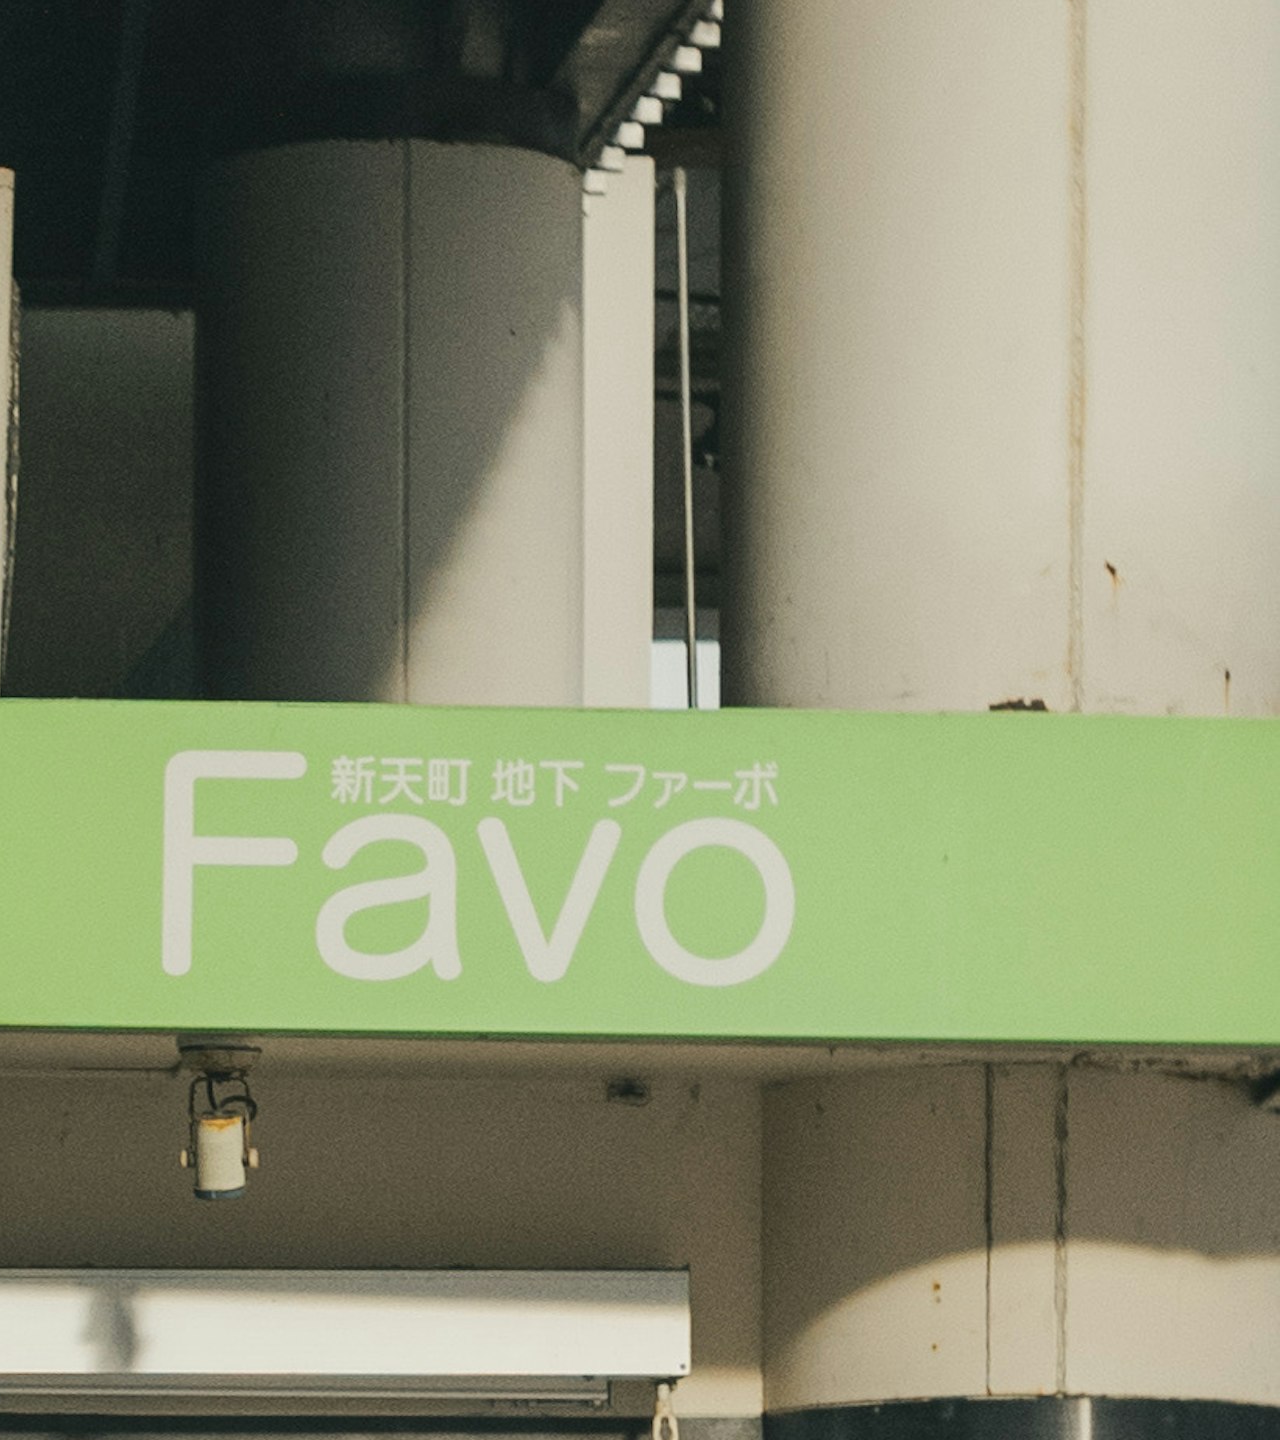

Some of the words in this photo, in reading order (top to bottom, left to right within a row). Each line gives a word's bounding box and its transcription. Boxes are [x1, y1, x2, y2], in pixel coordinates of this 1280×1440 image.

[330, 755, 472, 806] 新天町
[491, 758, 585, 807] 地下
[604, 761, 779, 810] ファーボ
[161, 749, 796, 987] Favo
